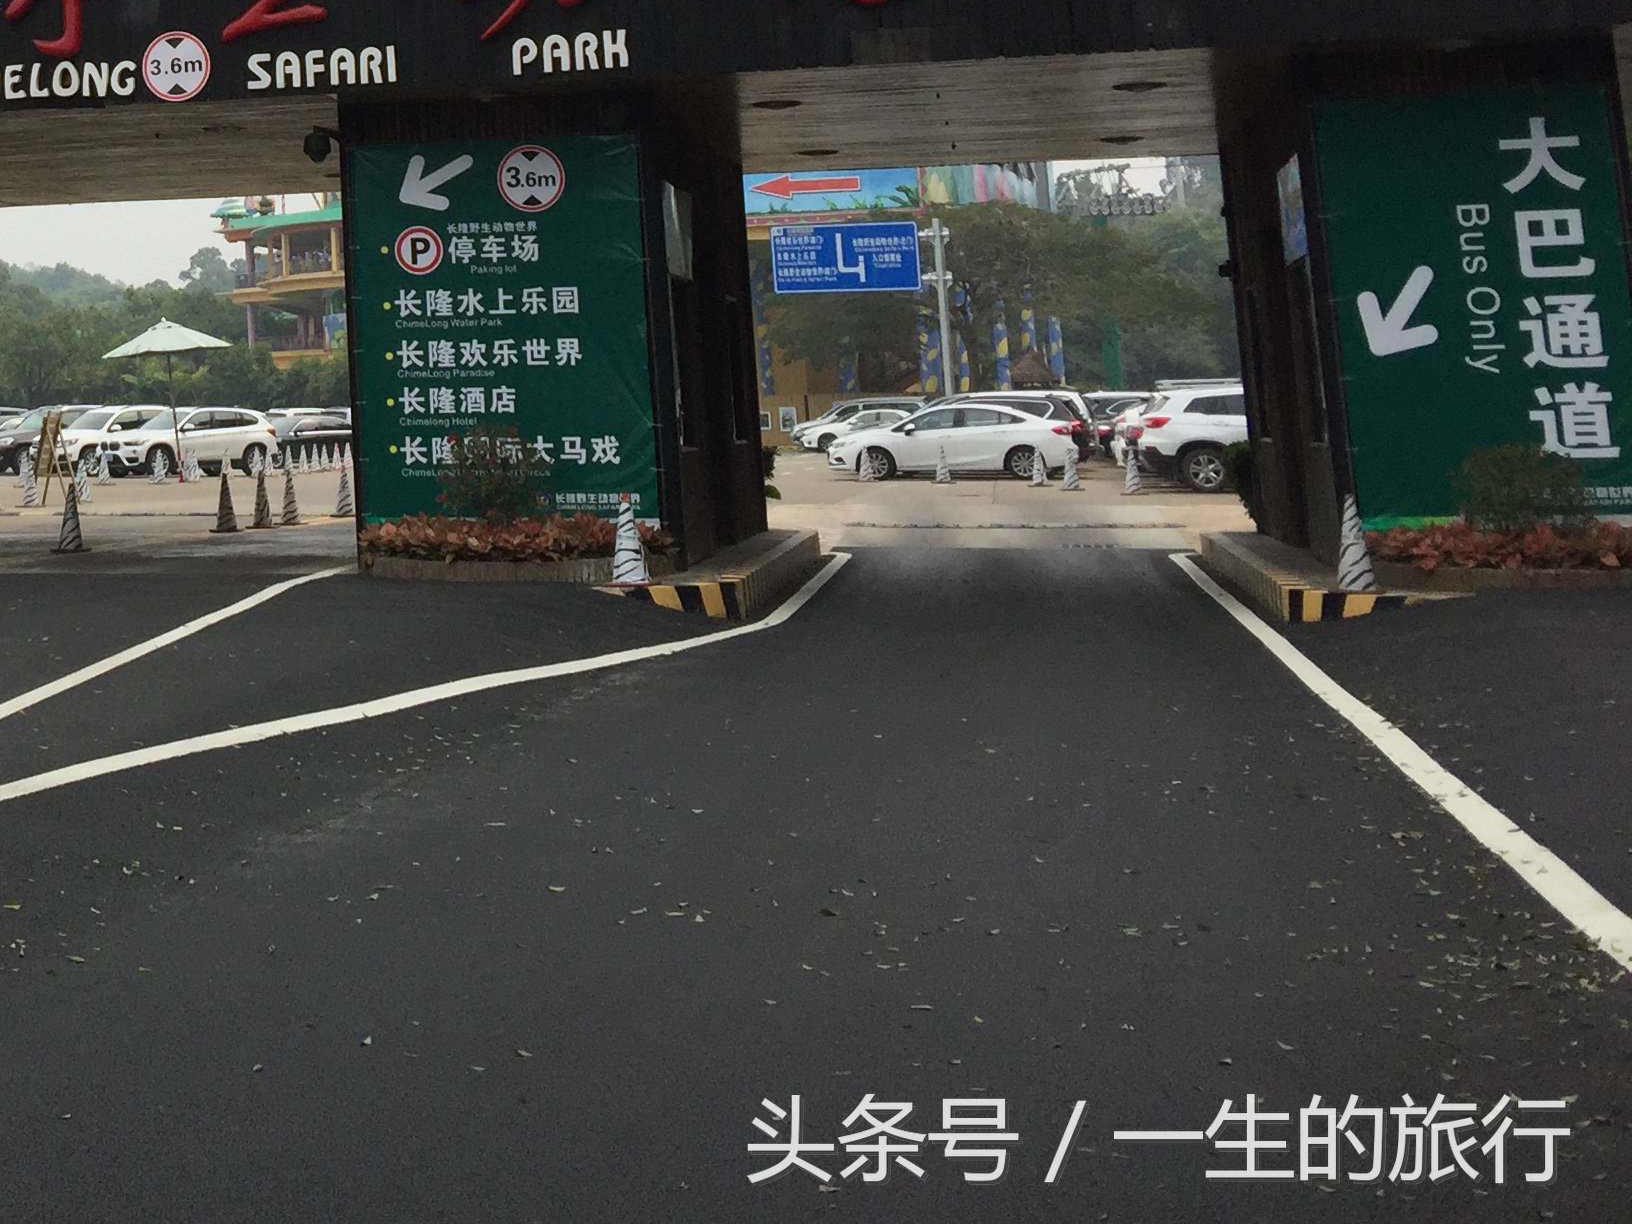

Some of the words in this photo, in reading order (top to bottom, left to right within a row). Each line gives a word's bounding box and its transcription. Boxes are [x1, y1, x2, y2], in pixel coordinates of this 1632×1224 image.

[150, 57, 204, 76] 3.6m
[247, 45, 397, 90] SAFARI
[512, 29, 629, 76] PARK
[505, 166, 557, 188] 3.6m
[448, 234, 540, 264] 停车场
[1456, 203, 1490, 274] Bus
[394, 286, 580, 318] 长隆水上乐园
[1499, 116, 1621, 459] 大巴通道
[1466, 286, 1506, 374] Only
[396, 338, 583, 369] 长隆欢乐世界
[398, 385, 517, 415] 长隆酒店
